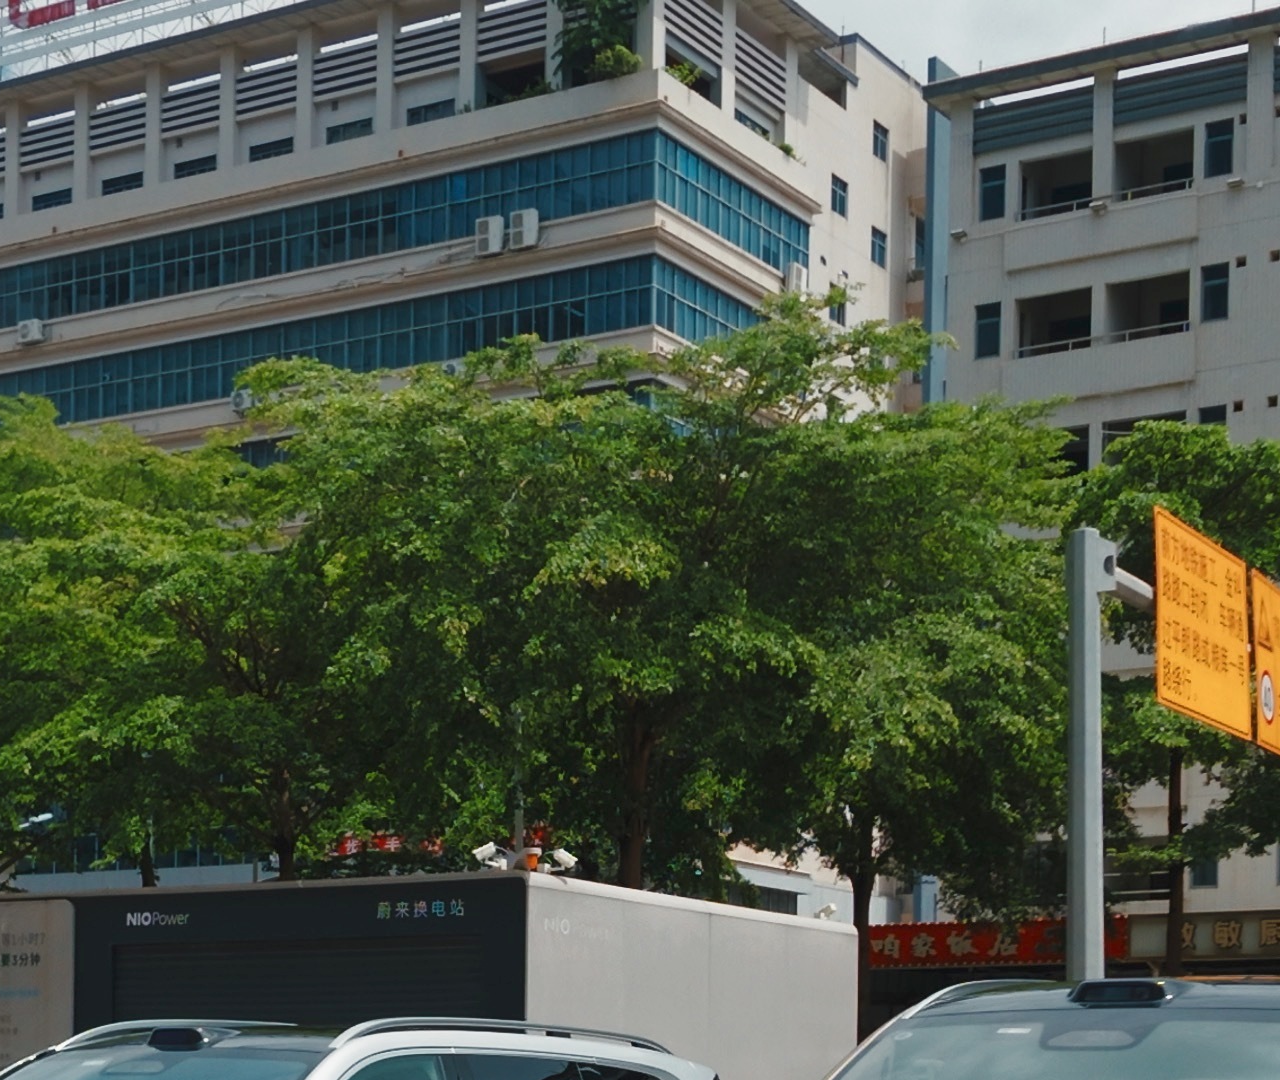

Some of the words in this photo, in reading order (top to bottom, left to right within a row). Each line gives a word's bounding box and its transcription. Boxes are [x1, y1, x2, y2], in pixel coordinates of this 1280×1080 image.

[376, 899, 465, 919] 蔚来换电站
[126, 912, 190, 926] NIOPower
